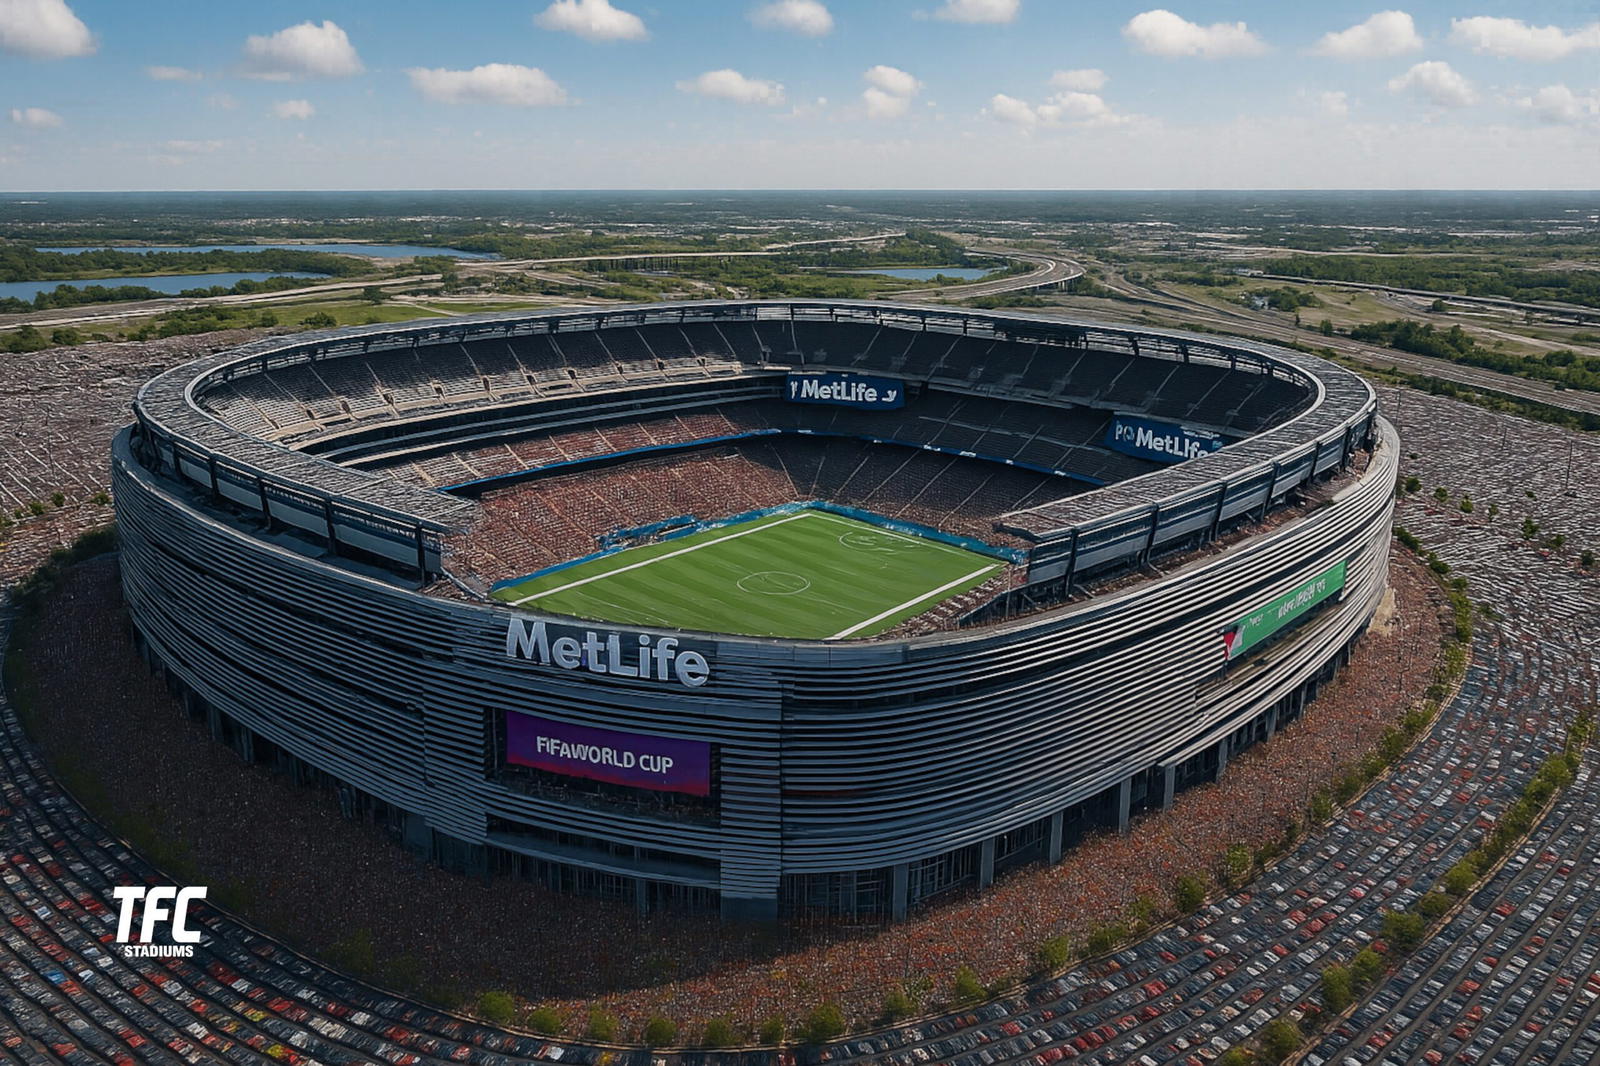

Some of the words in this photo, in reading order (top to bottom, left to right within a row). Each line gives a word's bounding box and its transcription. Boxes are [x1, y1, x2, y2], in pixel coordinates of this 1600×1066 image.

[800, 380, 878, 402] MetLife
[506, 613, 710, 688] MetLife
[639, 754, 673, 774] CUP
